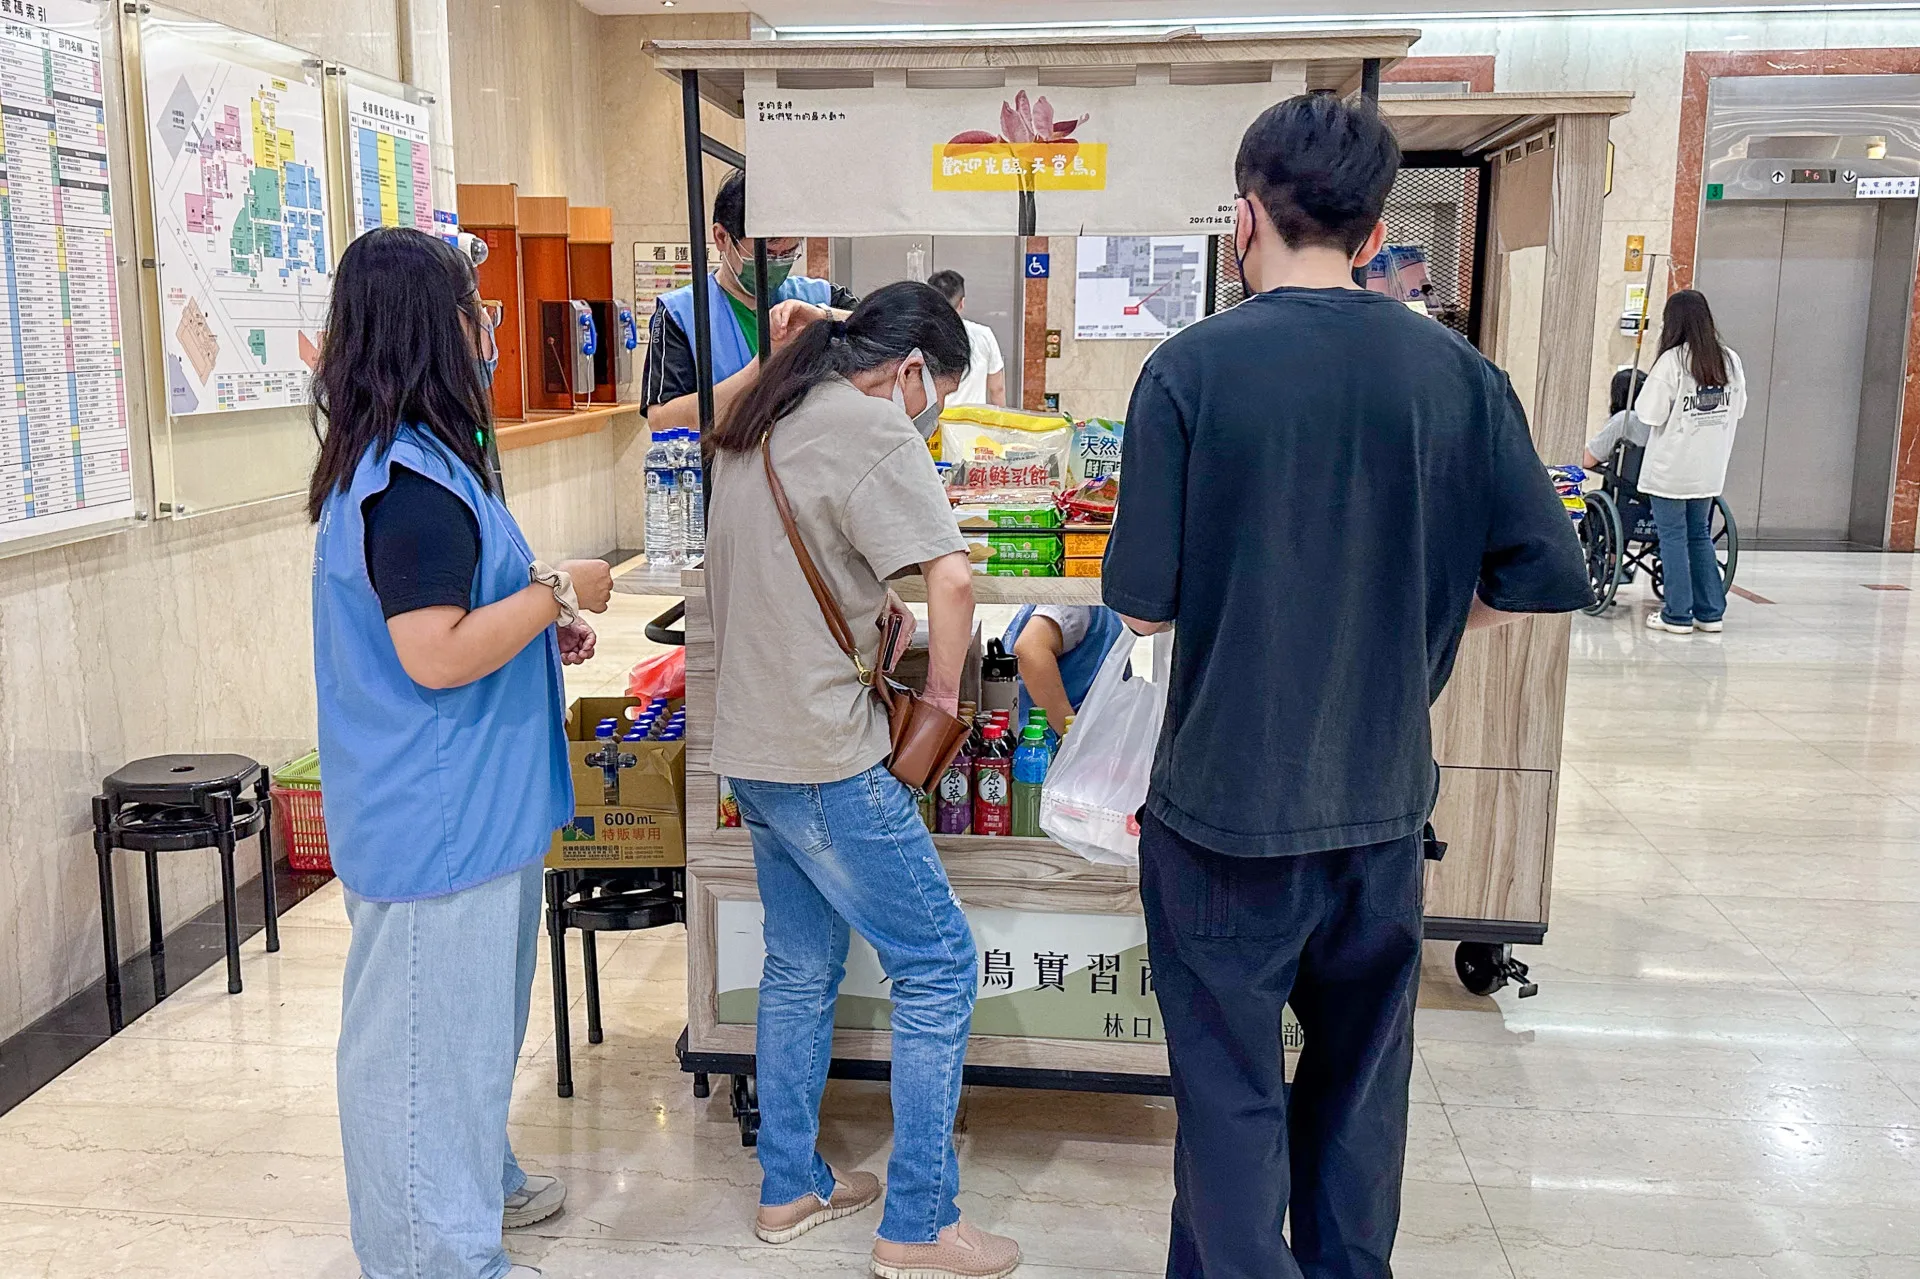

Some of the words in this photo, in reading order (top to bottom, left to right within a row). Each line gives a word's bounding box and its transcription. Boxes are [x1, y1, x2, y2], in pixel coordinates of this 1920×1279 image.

[759, 111, 846, 122] 是我們努力的最大動力
[1712, 186, 1719, 198] 3
[1080, 435, 1122, 456] 天然
[969, 464, 1049, 488] 純鮮乳餅
[982, 769, 1001, 806] 原萃
[604, 812, 635, 826] 600
[637, 814, 657, 825] mL
[602, 827, 661, 841] 特販專用
